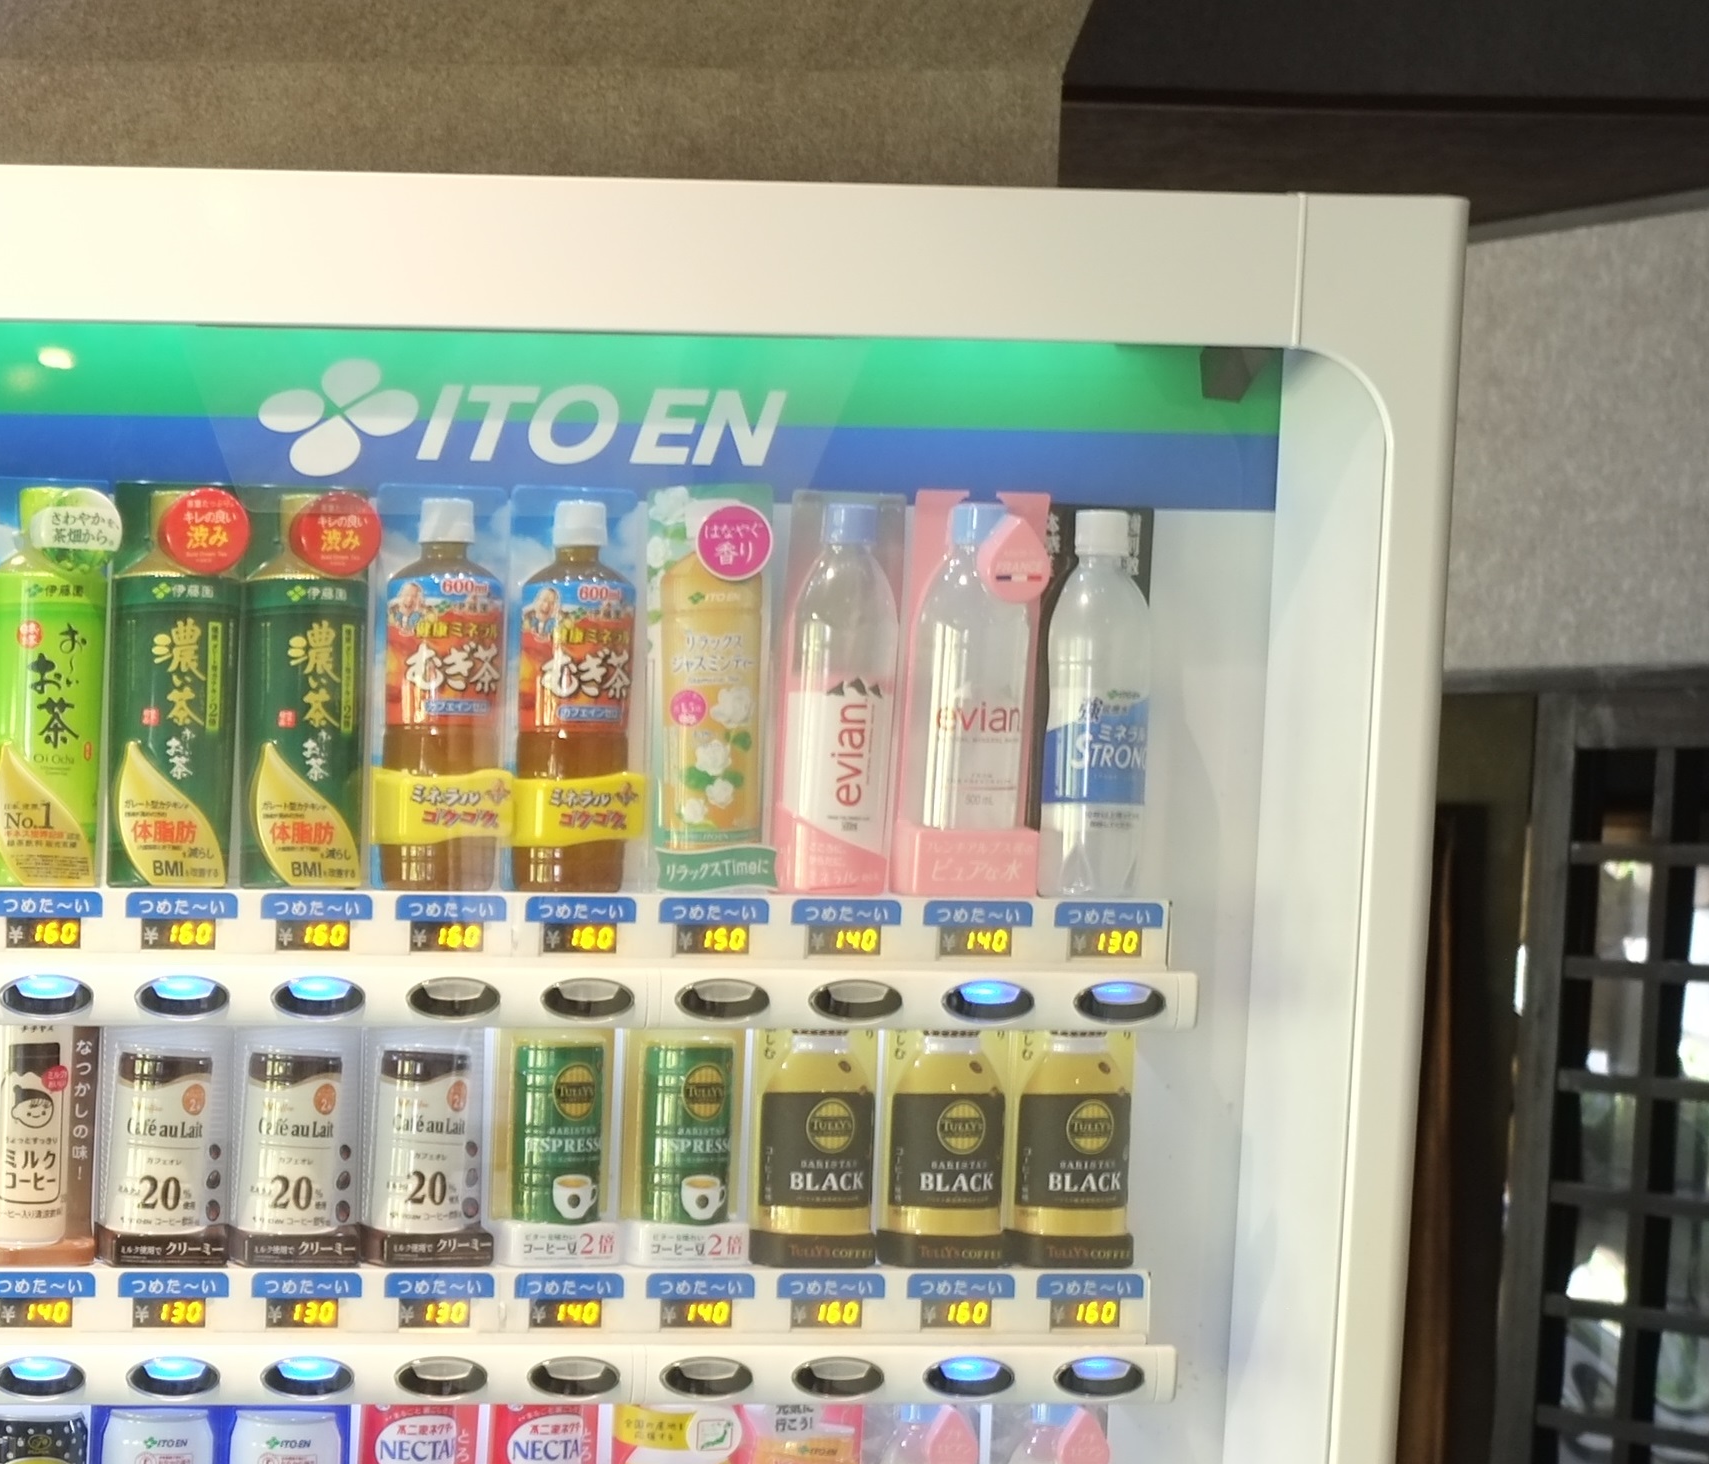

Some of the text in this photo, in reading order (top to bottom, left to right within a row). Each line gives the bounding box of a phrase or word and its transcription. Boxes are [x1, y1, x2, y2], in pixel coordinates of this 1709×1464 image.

[416, 384, 788, 466] ITO EN
[183, 511, 238, 524] キレの良い
[187, 526, 229, 549] 渋み
[321, 529, 361, 552] 渋み
[714, 541, 753, 566] 香り
[172, 584, 214, 599] 伊藤園
[406, 642, 500, 694] むぎ茶
[542, 647, 630, 699] むぎ茶
[936, 706, 1020, 733] evian
[831, 703, 868, 807] evian
[132, 820, 198, 845] 体脂肪
[269, 821, 335, 845] 体脂肪
[666, 860, 770, 881] リラックスTimeに
[159, 1122, 178, 1138] au
[180, 1121, 203, 1138] Lait
[4, 1149, 57, 1170] ミルク
[5, 1172, 57, 1191] コーヒー
[139, 1175, 181, 1211] 20
[790, 1172, 864, 1191] BLACK
[920, 1172, 994, 1192] BLACK
[1048, 1173, 1121, 1192] BLACK
[166, 1241, 224, 1256] クリーミー
